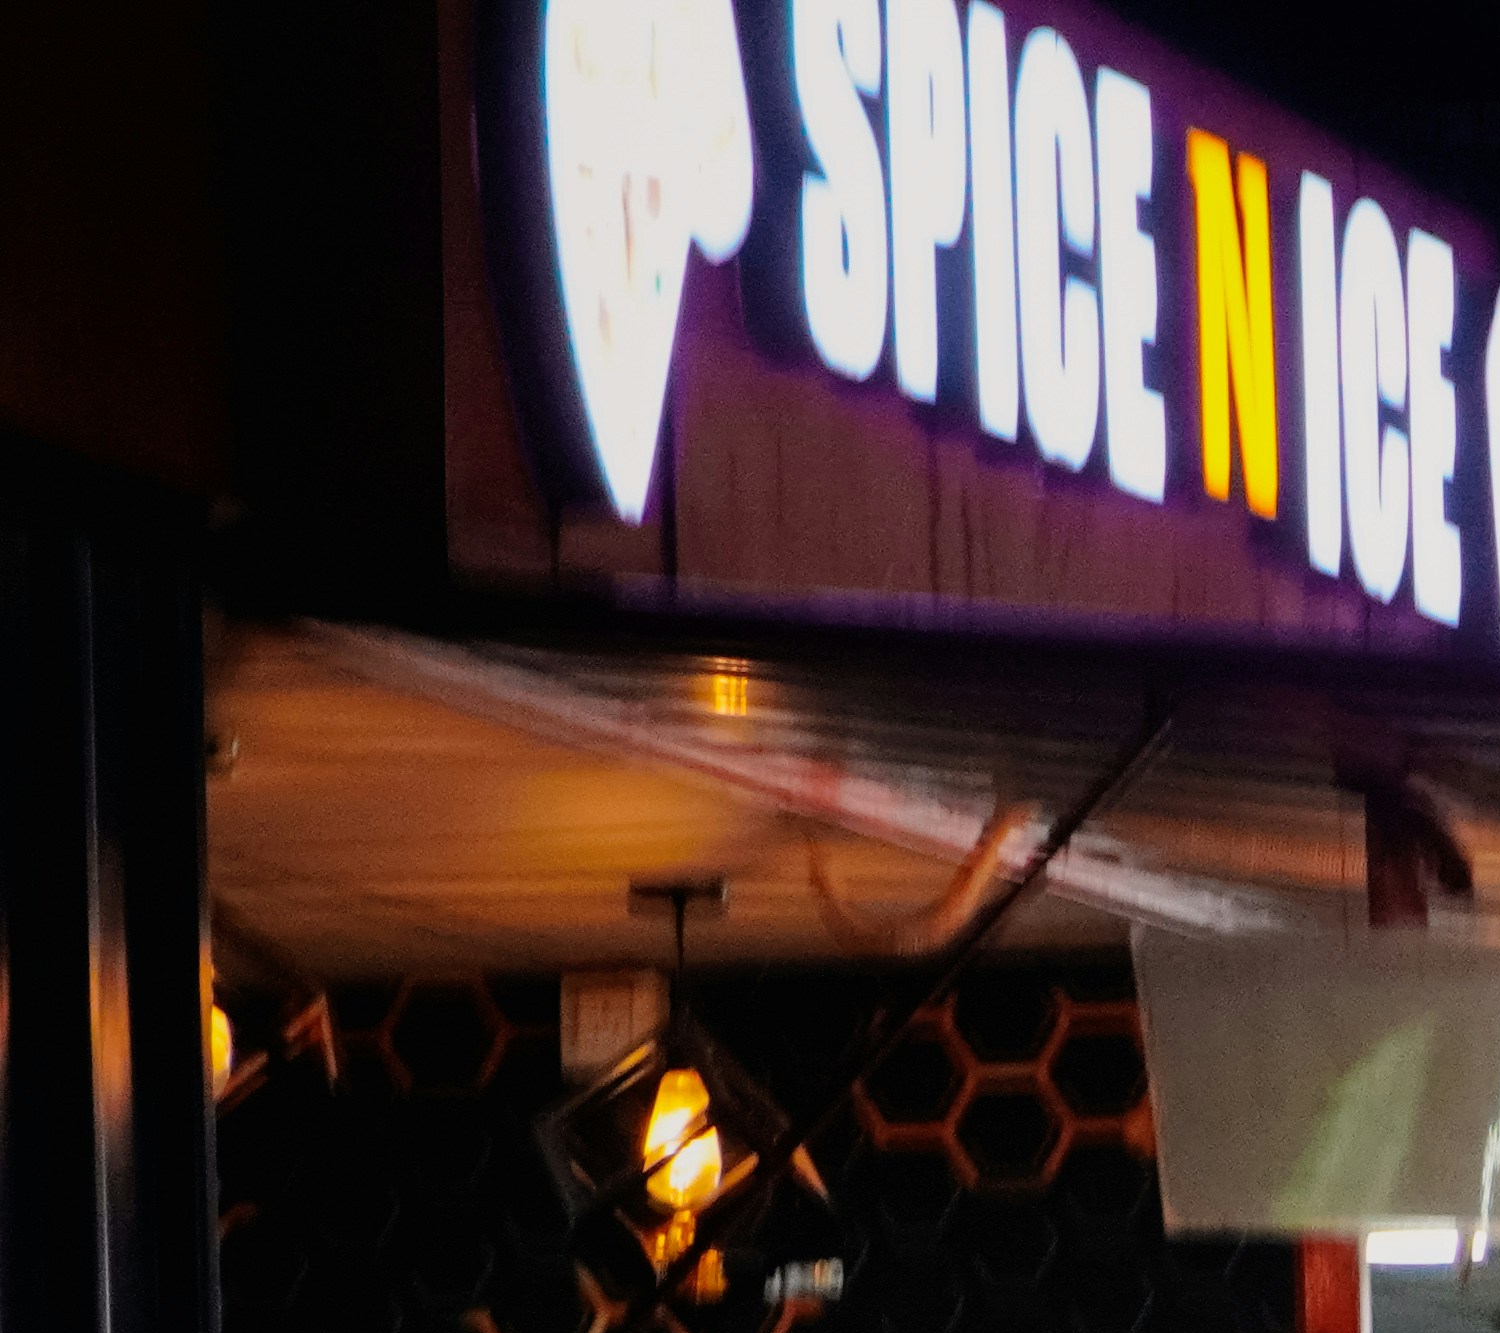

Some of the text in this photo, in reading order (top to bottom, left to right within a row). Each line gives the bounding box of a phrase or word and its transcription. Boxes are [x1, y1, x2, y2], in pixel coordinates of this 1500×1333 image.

[794, 0, 1168, 503] SPICE
[1185, 125, 1278, 519] N
[1297, 169, 1462, 626] ICE
